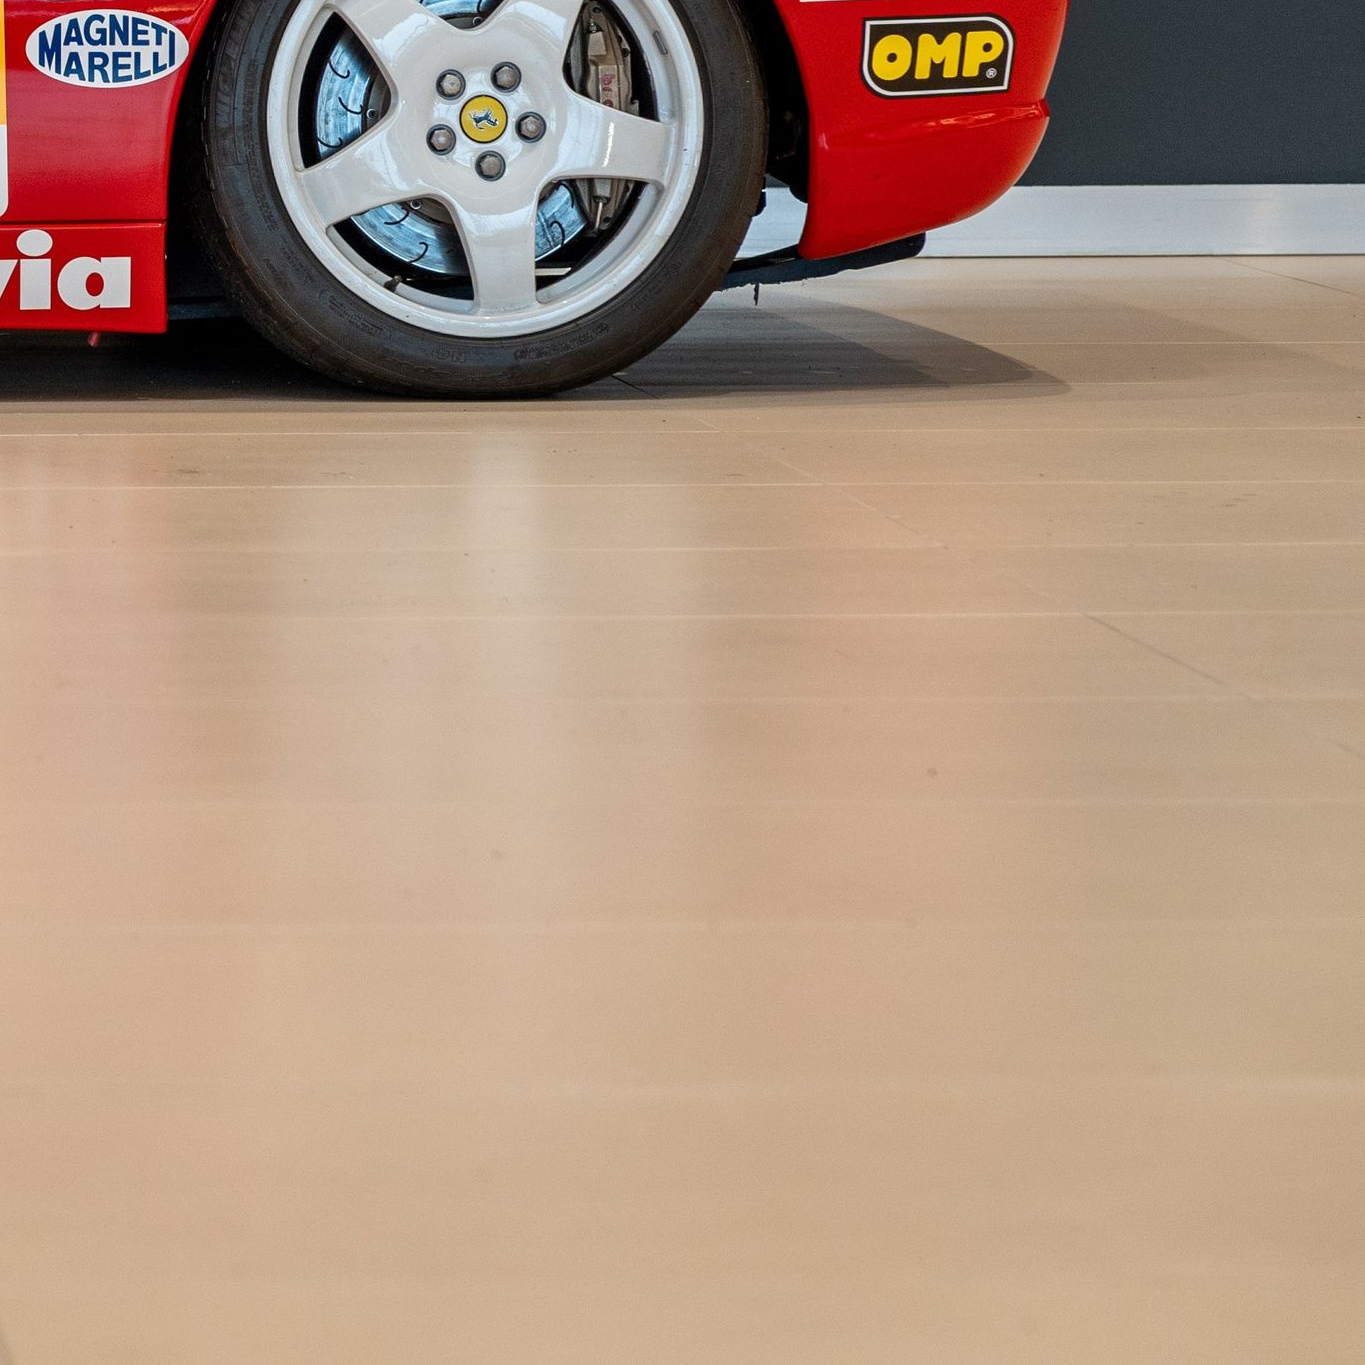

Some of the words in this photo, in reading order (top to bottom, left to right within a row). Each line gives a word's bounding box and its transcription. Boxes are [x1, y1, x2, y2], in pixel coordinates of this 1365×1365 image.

[38, 14, 176, 50] MAGNETI
[38, 48, 176, 84] MARELLI
[872, 31, 1005, 81] OMP
